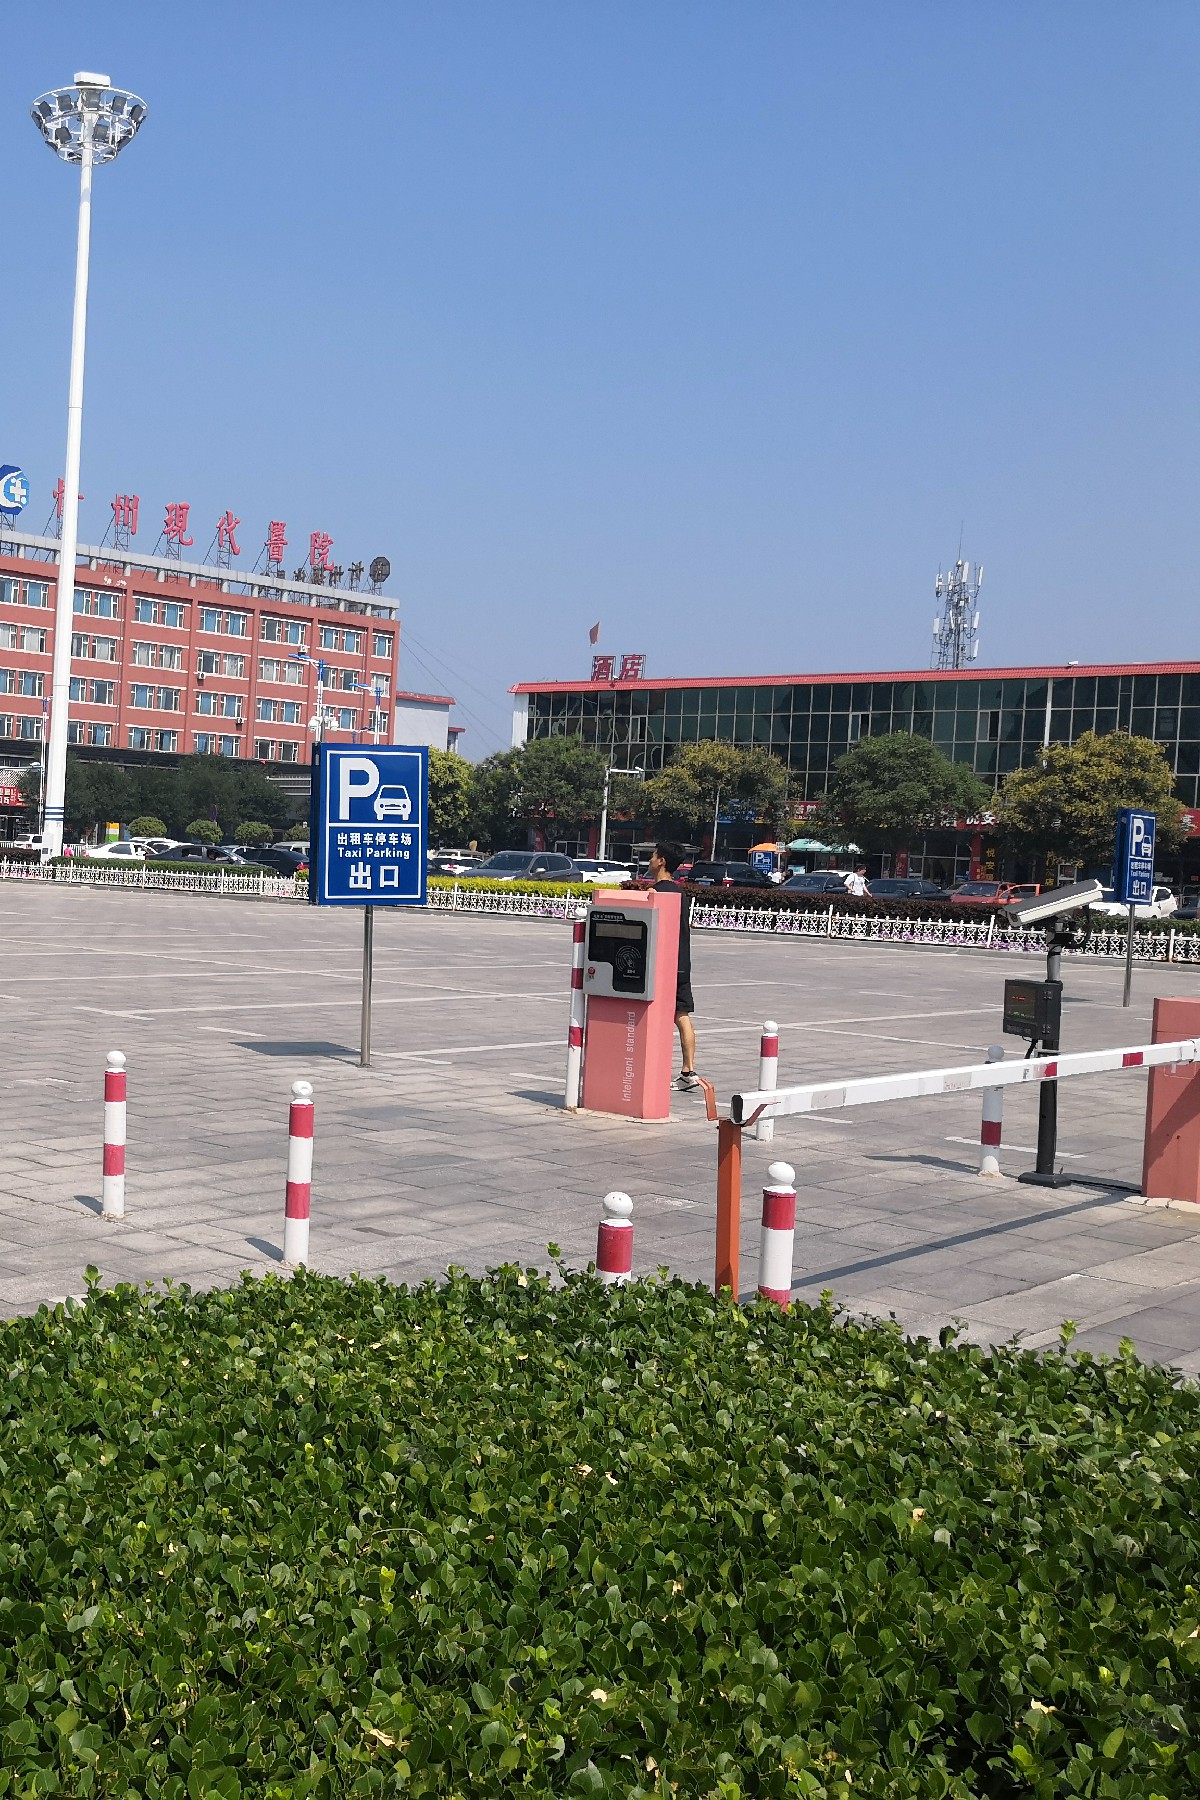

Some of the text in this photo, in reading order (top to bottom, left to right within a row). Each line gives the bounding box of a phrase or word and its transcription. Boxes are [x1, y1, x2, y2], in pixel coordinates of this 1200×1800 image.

[53, 478, 335, 571] 州現代醫院
[591, 653, 644, 681] 酒店
[339, 757, 380, 821] P
[337, 832, 412, 846] 出租车停车场
[1131, 818, 1145, 856] P
[337, 847, 410, 859] Taxi Parking
[349, 861, 399, 890] 出口
[1132, 879, 1147, 896] 出口
[622, 1011, 636, 1103] Intelligent standard
